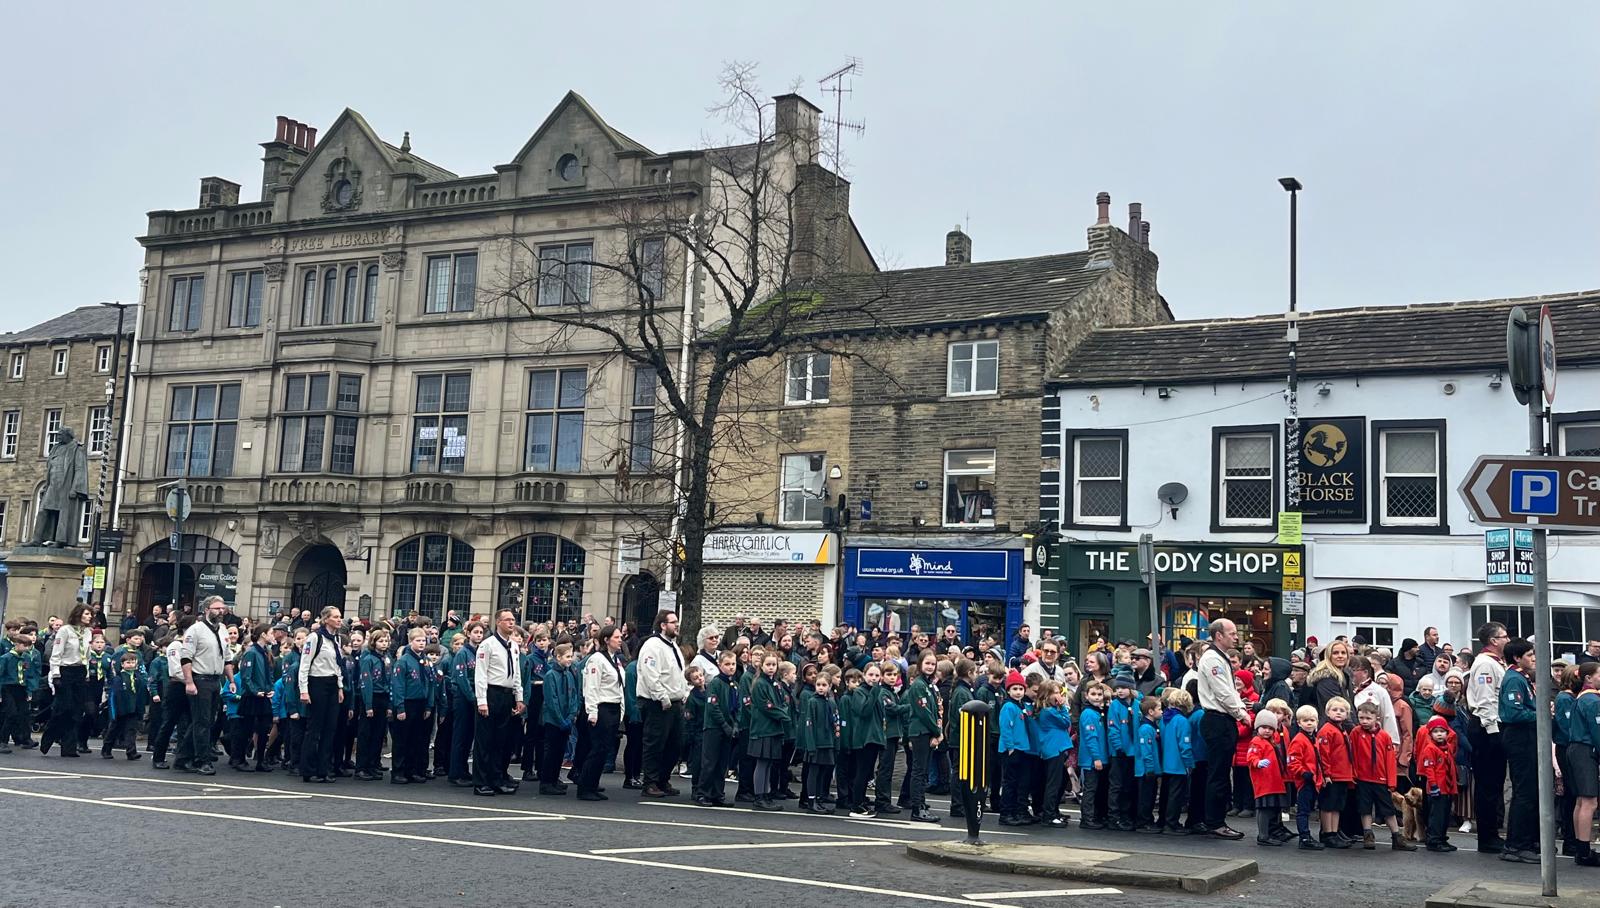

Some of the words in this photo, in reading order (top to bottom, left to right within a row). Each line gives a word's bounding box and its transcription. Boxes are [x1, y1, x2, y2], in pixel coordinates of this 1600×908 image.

[290, 238, 324, 251] FREE
[331, 231, 388, 248] LIBRARY
[1297, 472, 1354, 486] BLACK
[1298, 488, 1354, 501] HORSE
[1522, 475, 1552, 510] P
[712, 536, 740, 551] HARRY
[742, 536, 790, 550] GARLICK
[1085, 551, 1130, 571] THE
[1153, 552, 1203, 573] ODY
[1491, 551, 1506, 561] SHOP
[1520, 551, 1534, 561] SHO
[1487, 562, 1497, 574] TO
[1497, 561, 1510, 573] LET
[1515, 561, 1528, 573] TO
[219, 573, 237, 582] Colleg
[1174, 610, 1193, 624] HEY
